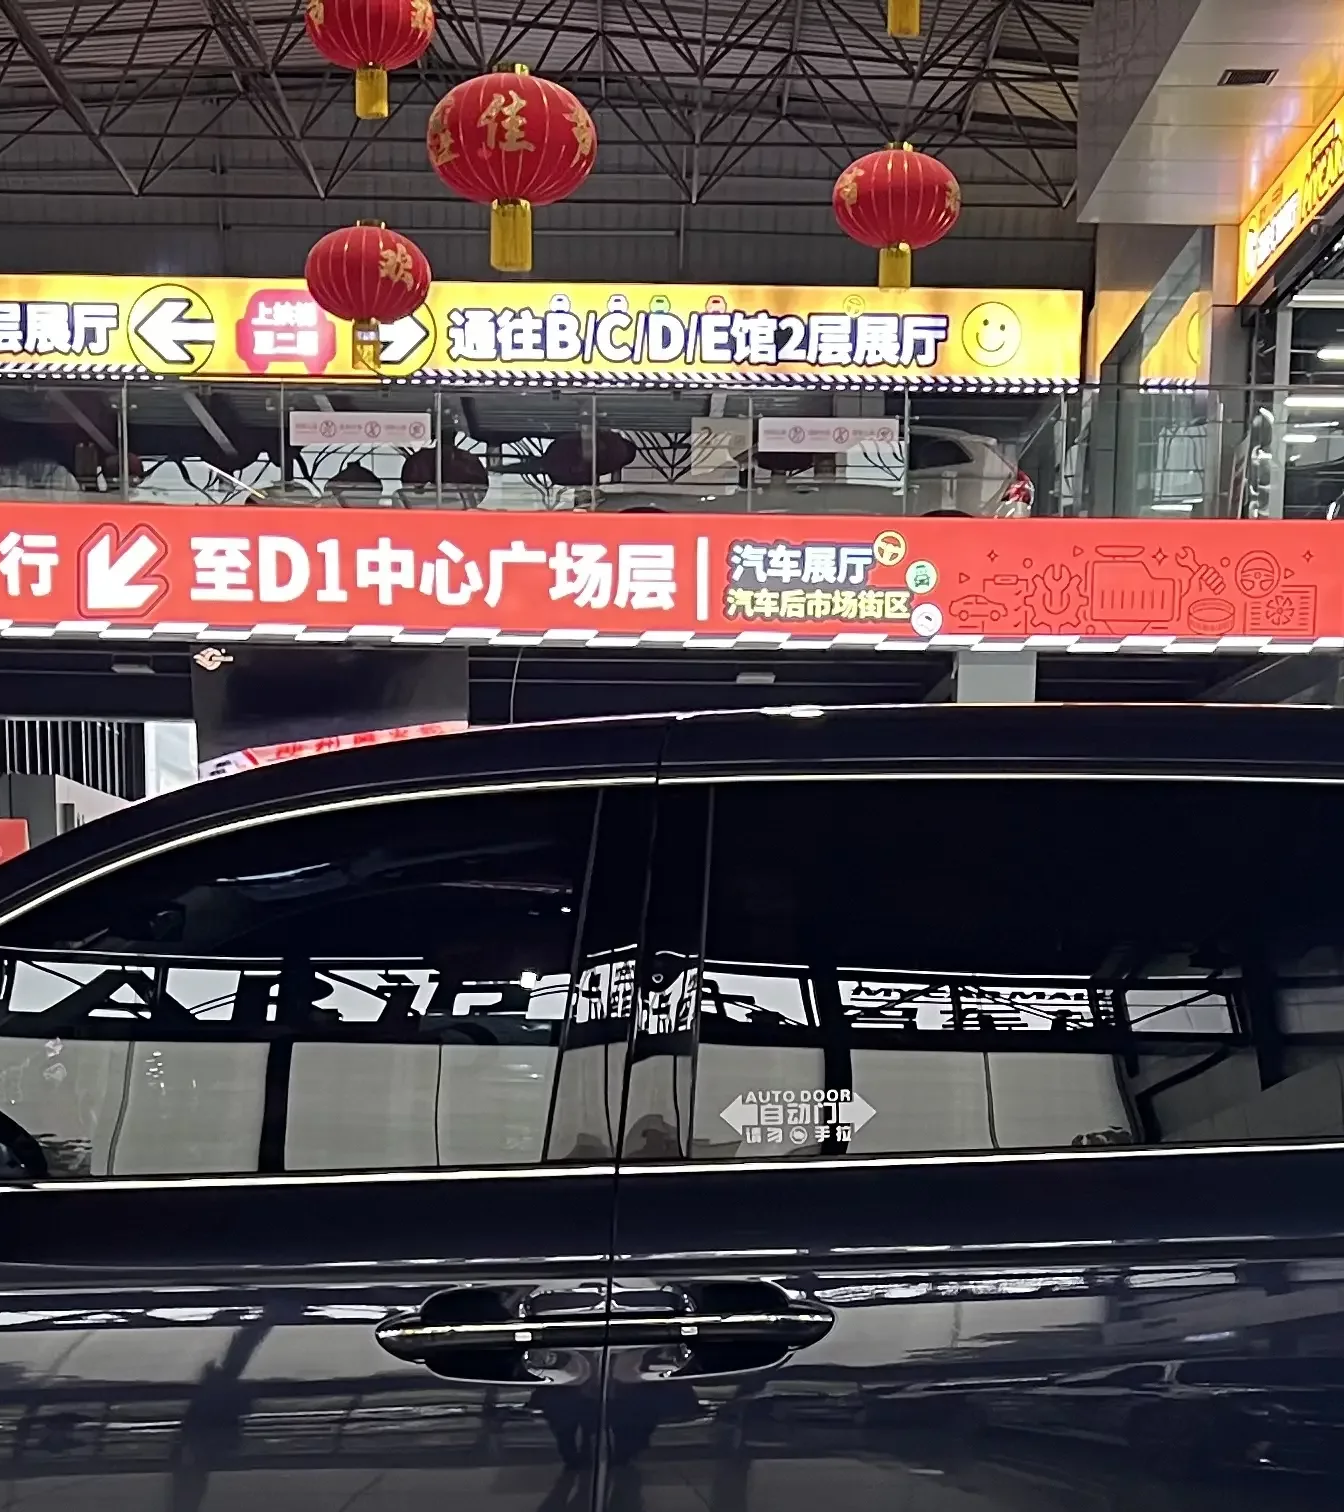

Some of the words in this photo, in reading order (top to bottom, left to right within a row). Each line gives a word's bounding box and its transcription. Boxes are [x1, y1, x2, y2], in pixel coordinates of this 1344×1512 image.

[448, 311, 948, 368] 通往B/C/D/E馆2层展厅
[190, 535, 678, 611] 至D1中心广场层
[731, 544, 873, 584] 汽车展厅
[726, 588, 911, 619] 汽车后市场街区
[745, 1090, 796, 1104] AUTO
[800, 1089, 851, 1103] DOOR
[760, 1103, 837, 1126] 自动门
[814, 1125, 852, 1143] 手拉
